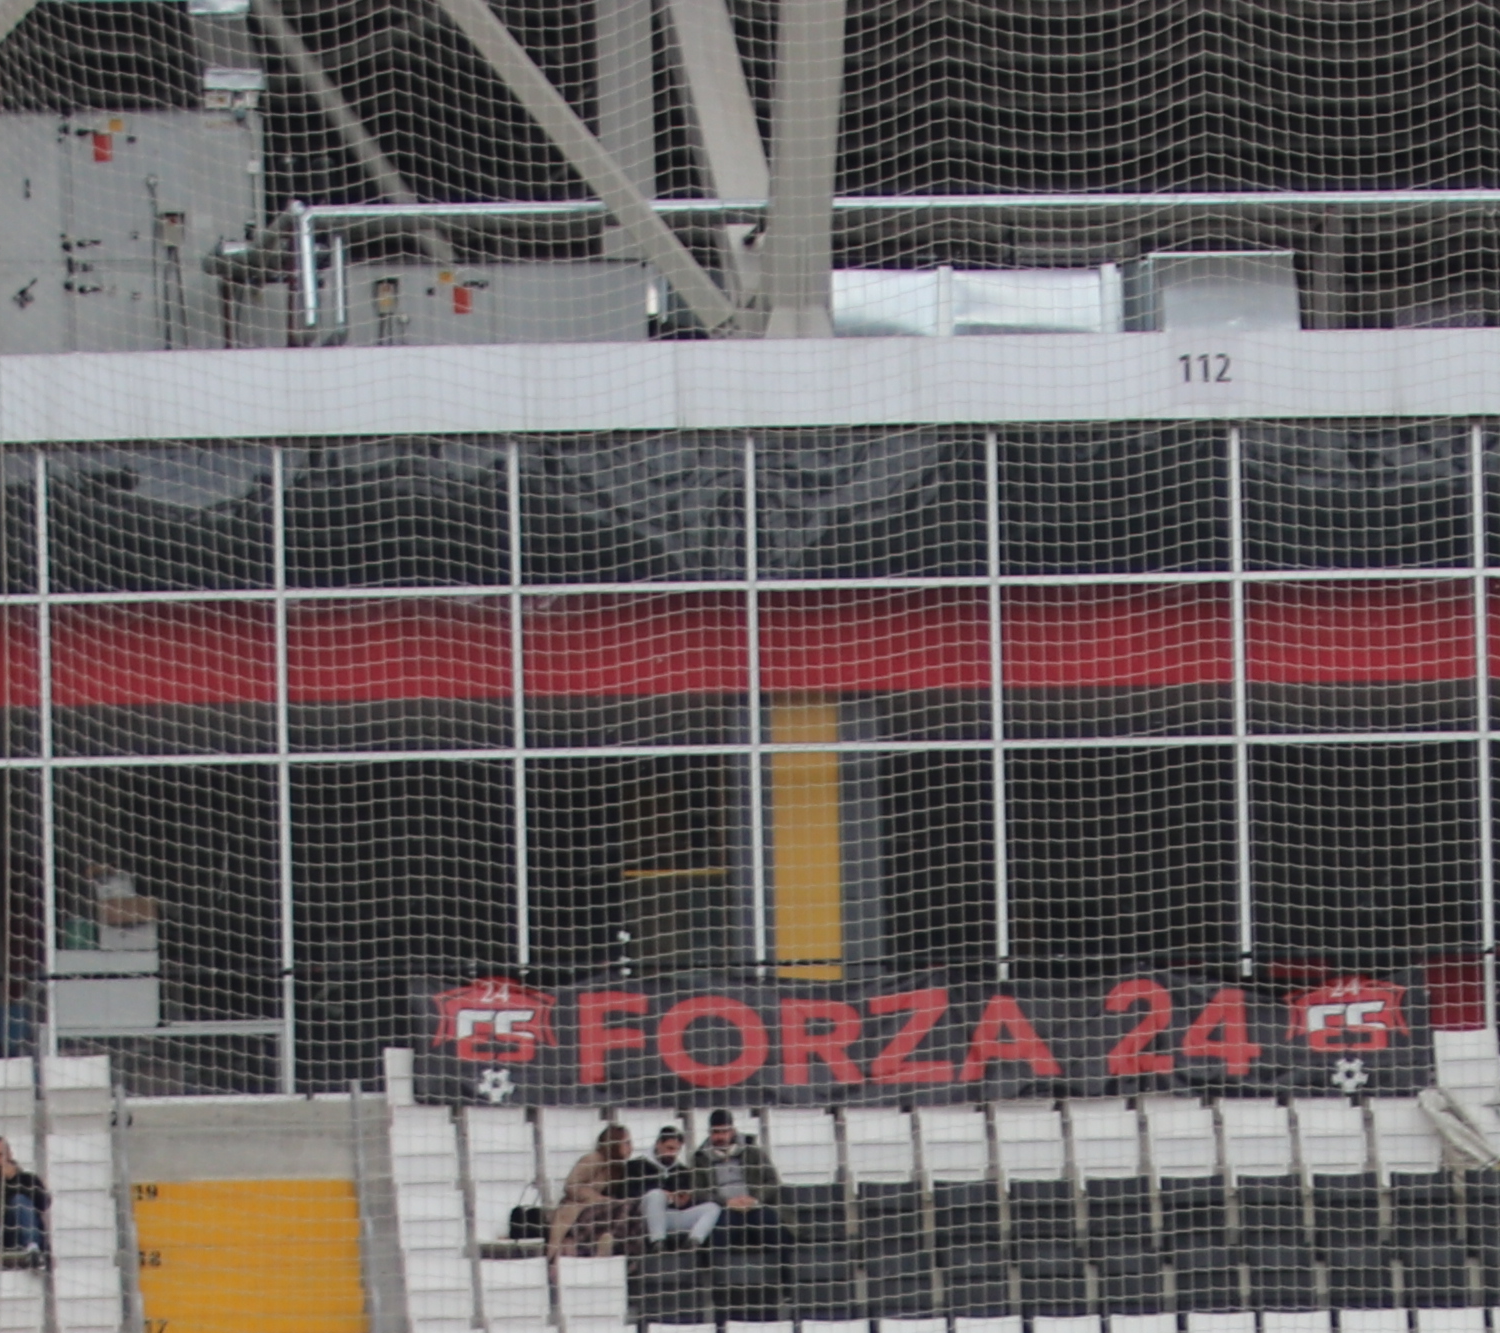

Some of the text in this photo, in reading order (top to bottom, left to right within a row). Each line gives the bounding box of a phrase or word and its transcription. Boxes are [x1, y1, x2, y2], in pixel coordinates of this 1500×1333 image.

[1178, 352, 1233, 383] 112
[578, 978, 1263, 1088] FORZA 24
